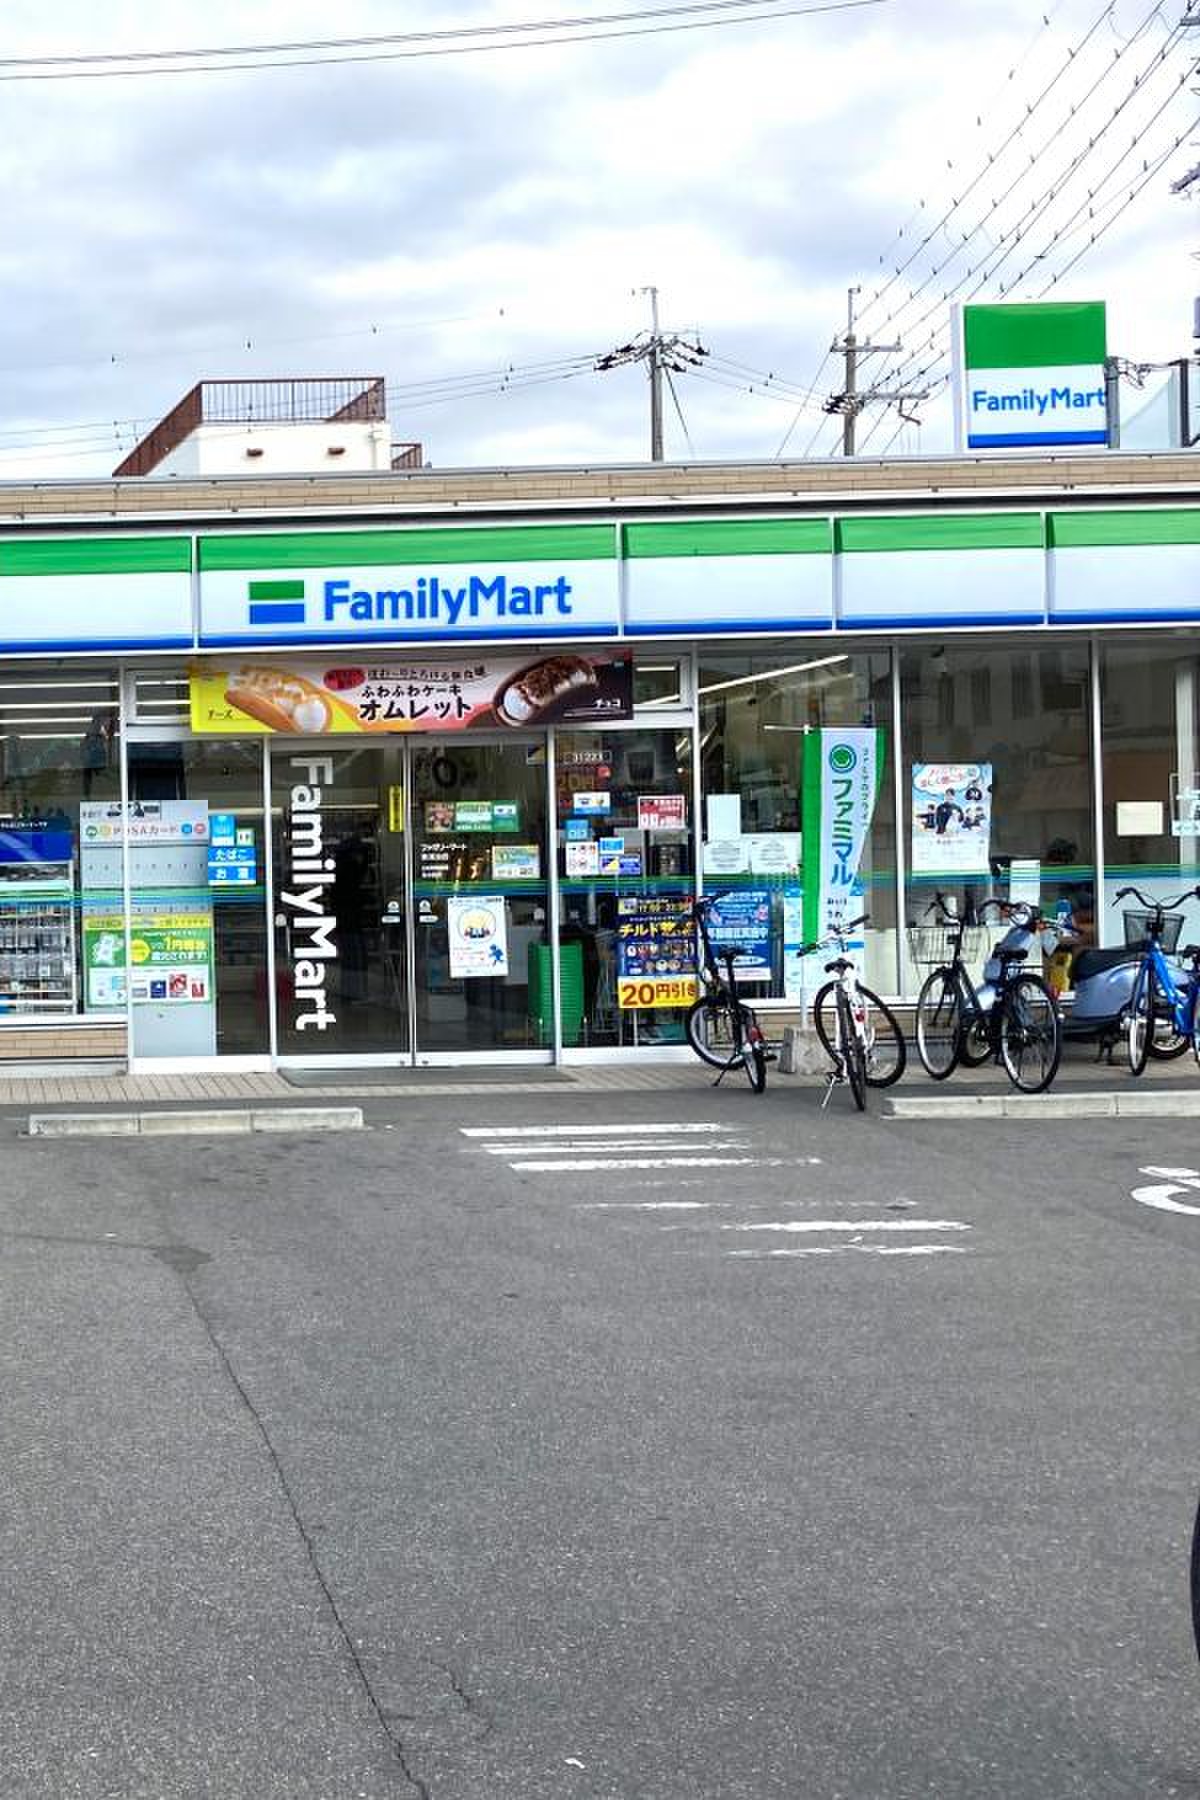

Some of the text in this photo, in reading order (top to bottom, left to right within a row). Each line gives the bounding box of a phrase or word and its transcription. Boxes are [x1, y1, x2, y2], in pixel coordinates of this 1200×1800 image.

[973, 387, 1106, 415] FamilyMart
[323, 575, 573, 624] FamilyMart
[361, 685, 462, 698] ふわふわケーキ
[359, 699, 473, 721] オムレット
[830, 779, 855, 885] ファミマル
[281, 757, 337, 1031] FamilyMart
[622, 982, 697, 1006] 20円引き
